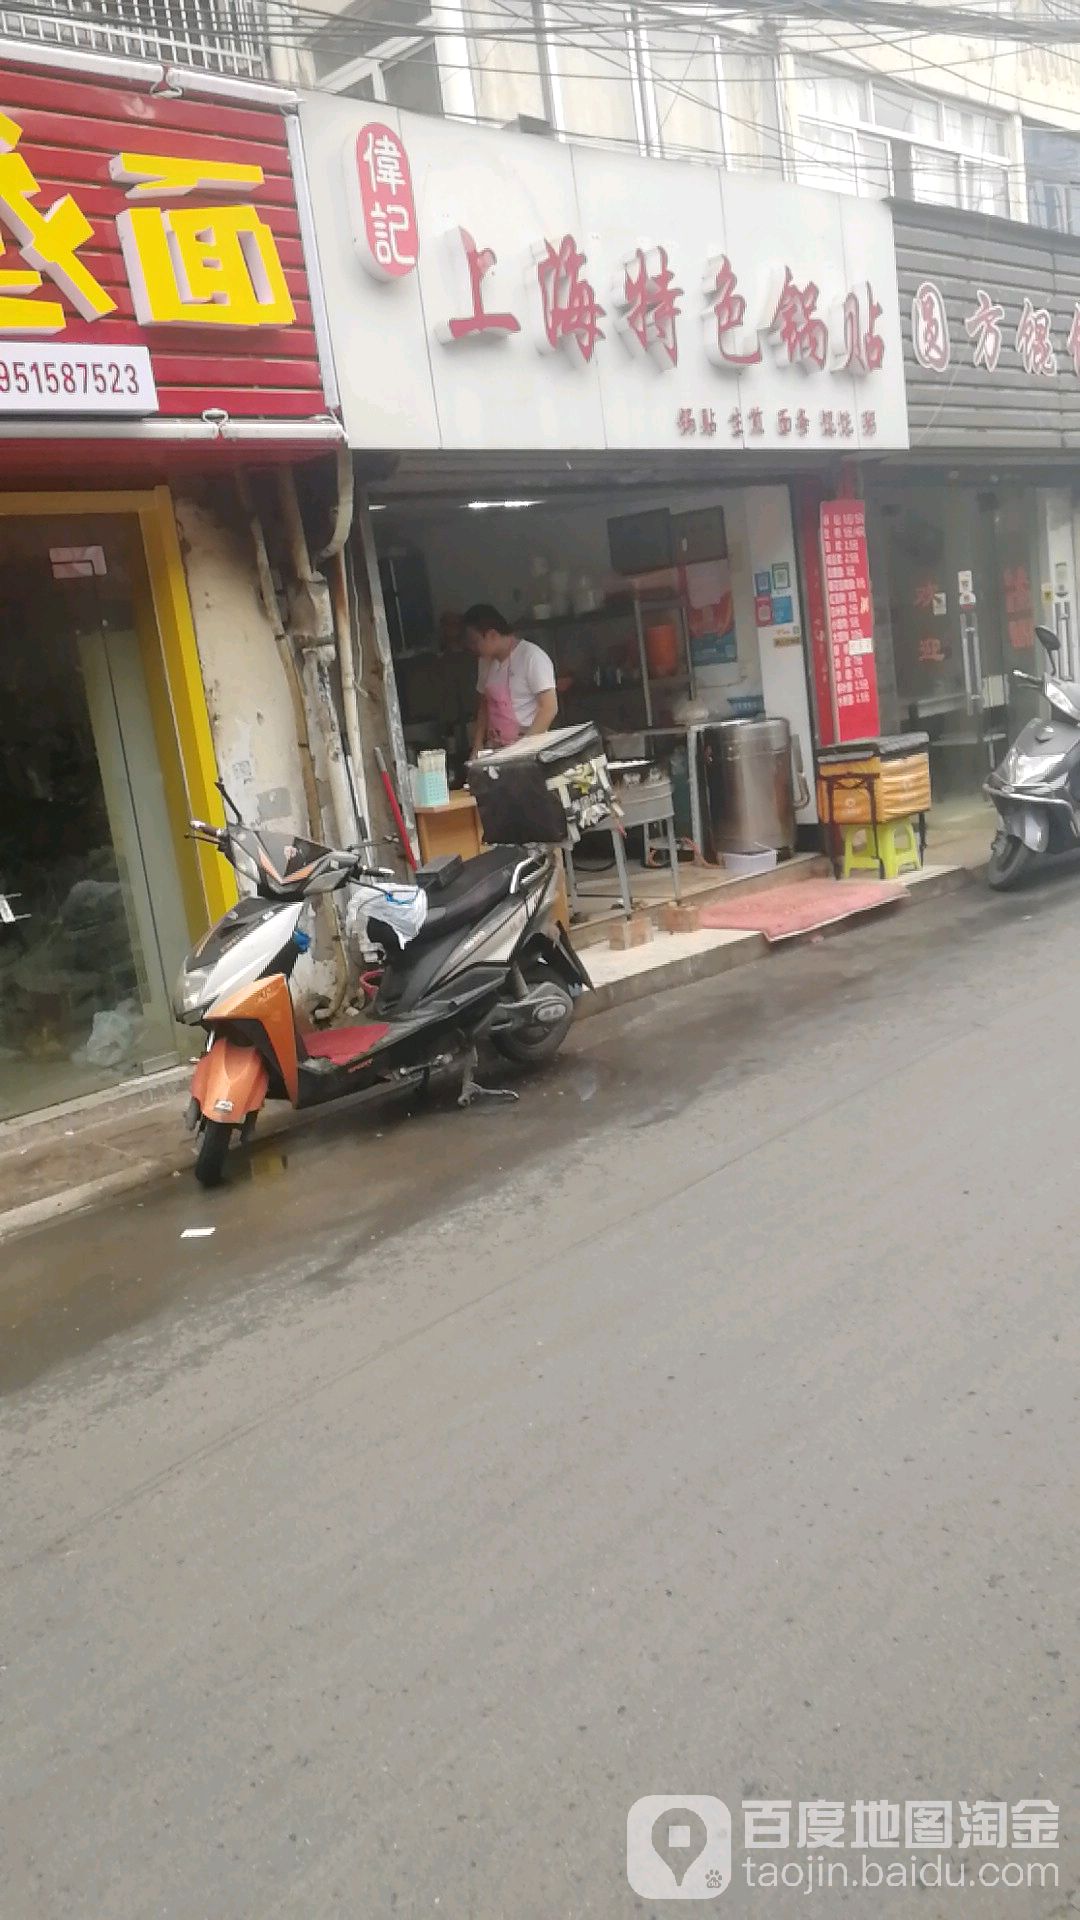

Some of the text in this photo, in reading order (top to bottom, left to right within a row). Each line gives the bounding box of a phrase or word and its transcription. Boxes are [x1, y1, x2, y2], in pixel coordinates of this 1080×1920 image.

[444, 226, 885, 371] 上海特色锅贴
[911, 281, 1080, 377] 圆方馄
